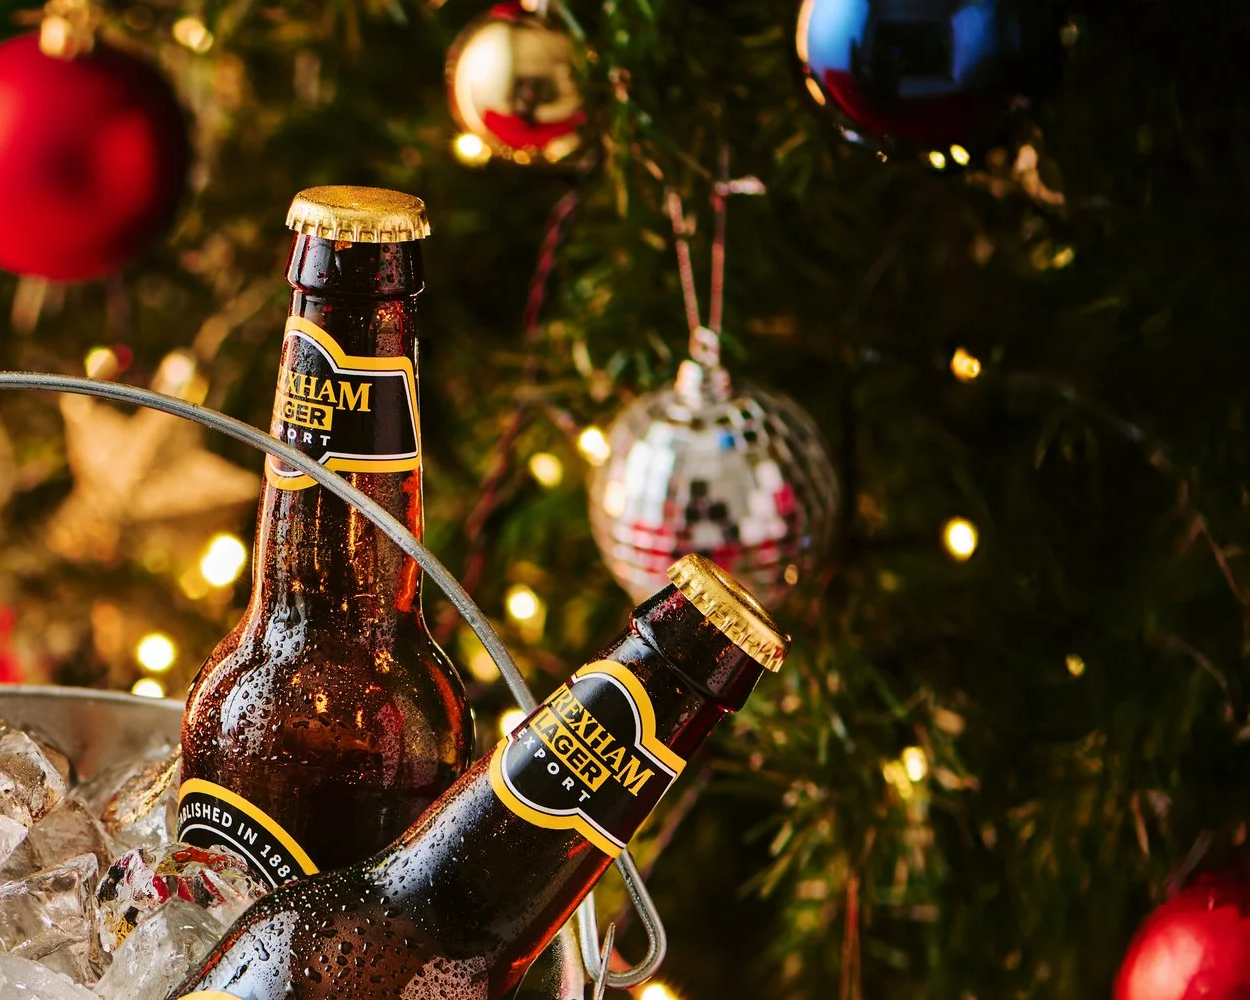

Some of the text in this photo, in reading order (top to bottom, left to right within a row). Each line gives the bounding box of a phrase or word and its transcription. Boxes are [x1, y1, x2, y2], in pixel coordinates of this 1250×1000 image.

[517, 728, 591, 803] EXPORT
[535, 712, 602, 785] LAGER
[237, 822, 258, 845] IN
